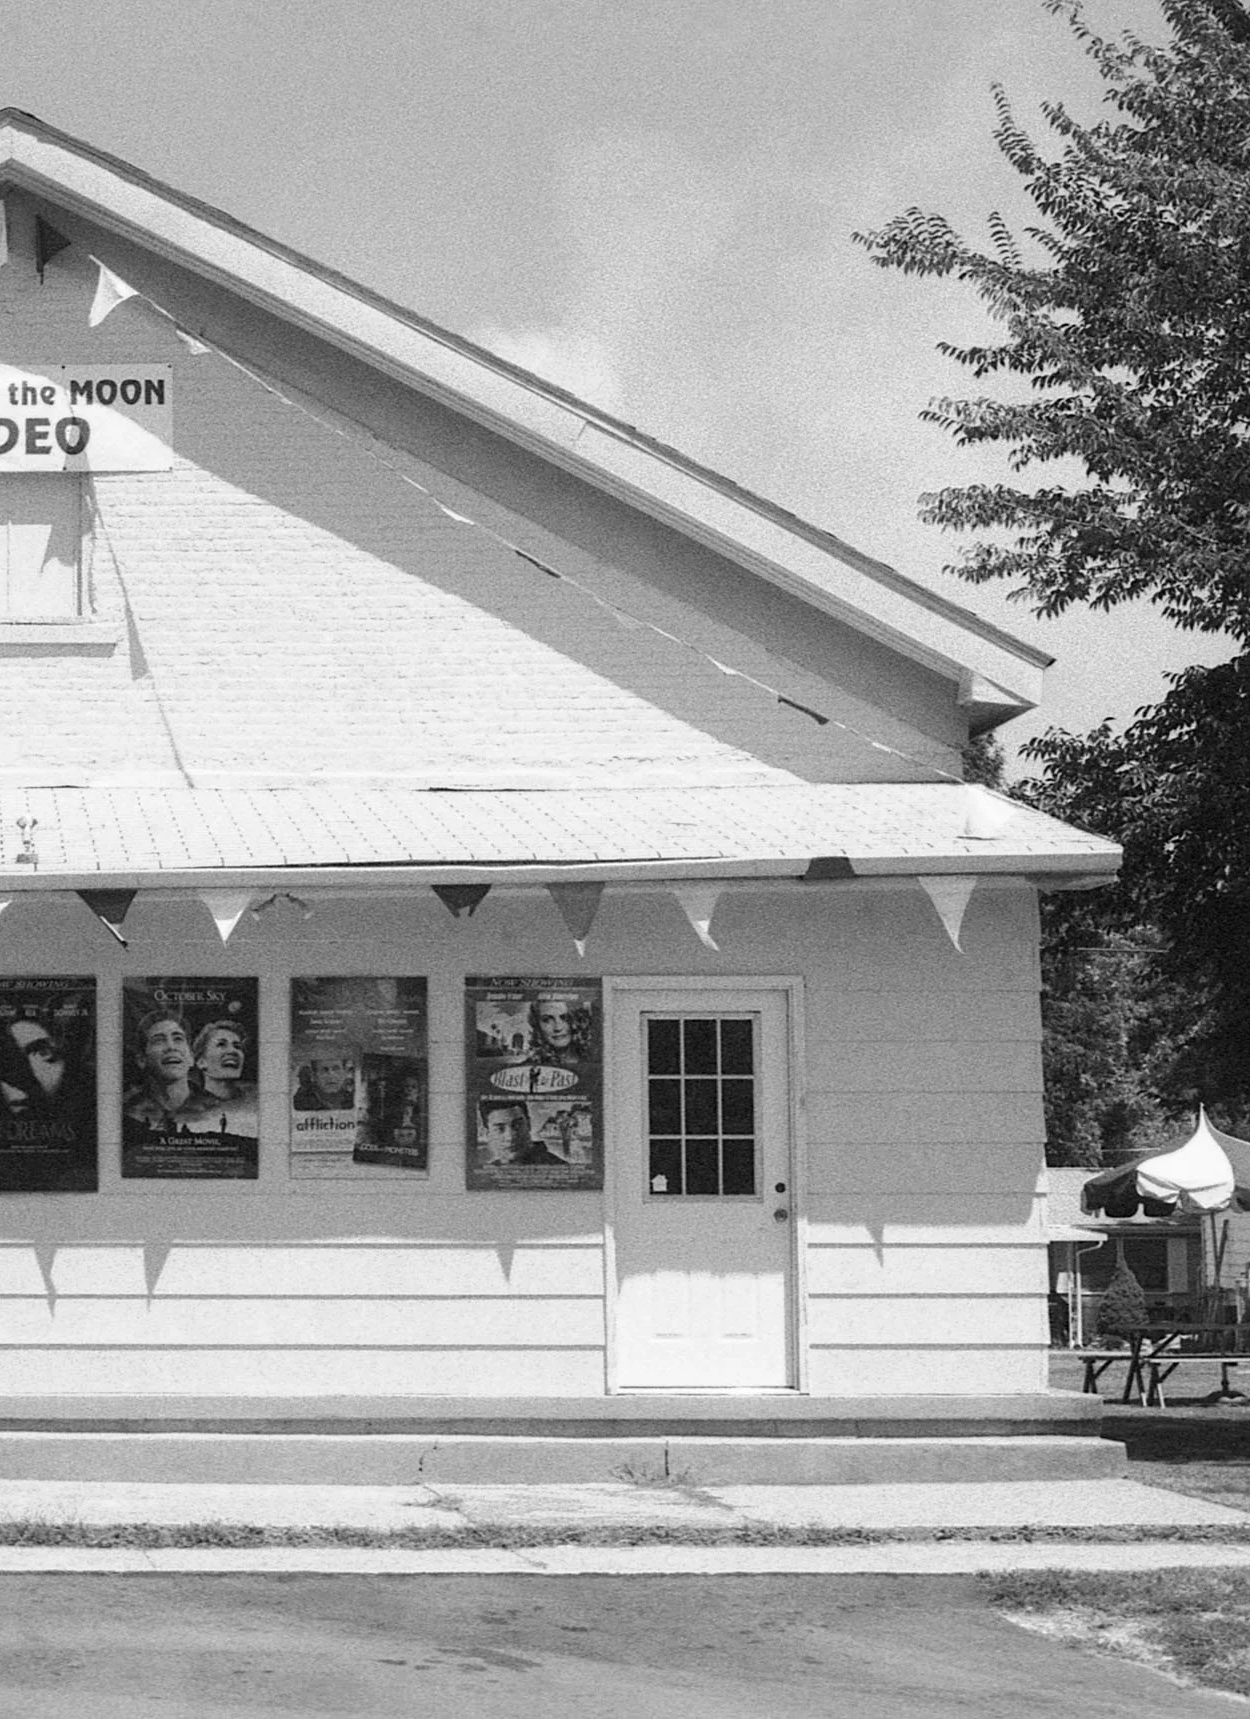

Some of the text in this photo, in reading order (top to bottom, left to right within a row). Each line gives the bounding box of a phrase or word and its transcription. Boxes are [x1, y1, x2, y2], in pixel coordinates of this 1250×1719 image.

[8, 381, 56, 406] the
[69, 379, 166, 405] MOON
[295, 1117, 356, 1131] affliction
